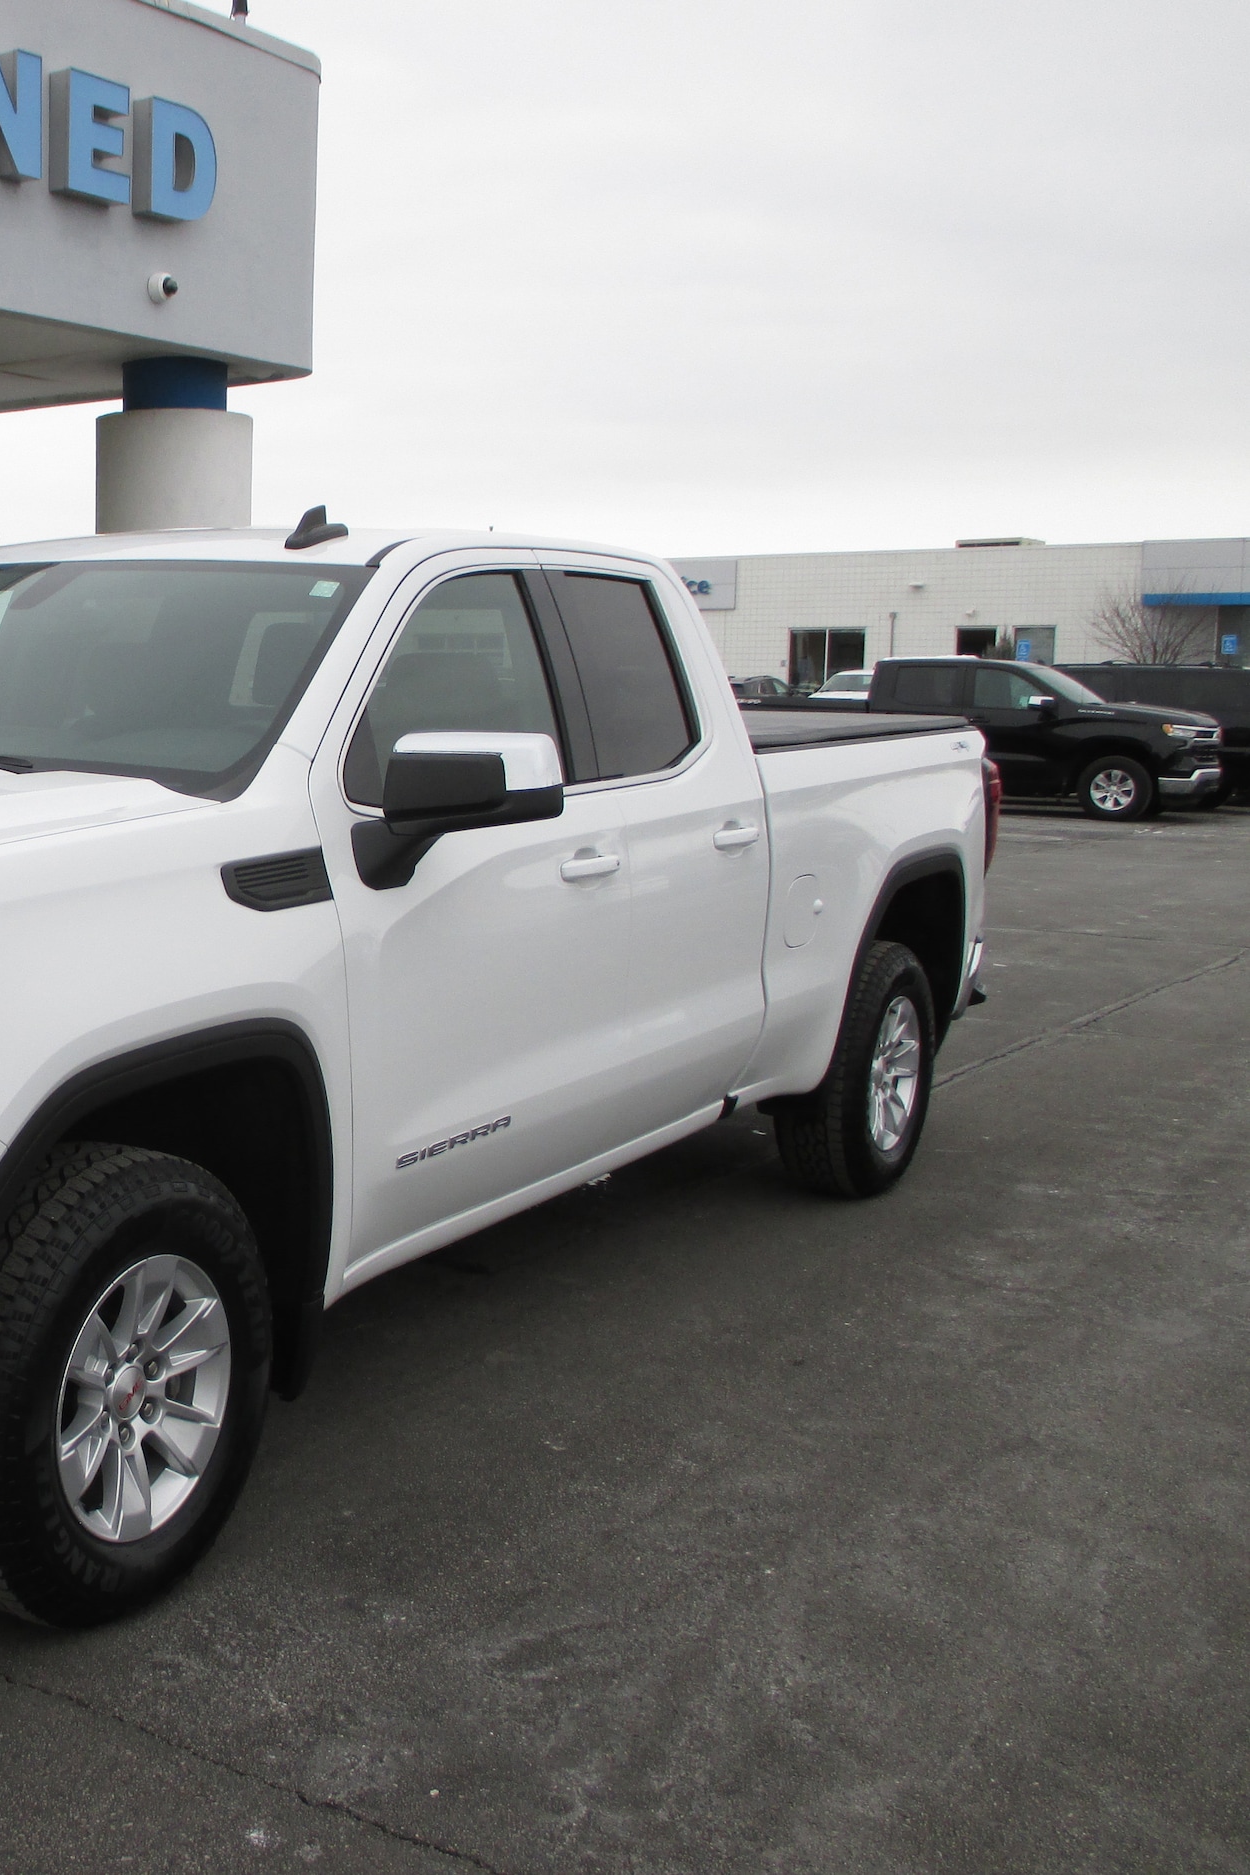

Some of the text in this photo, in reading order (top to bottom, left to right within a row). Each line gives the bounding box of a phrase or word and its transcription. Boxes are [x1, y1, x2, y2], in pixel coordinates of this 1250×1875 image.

[396, 1114, 511, 1169] SIERRA
[119, 1376, 143, 1411] GMC
[34, 1453, 130, 1593] RANGLER
